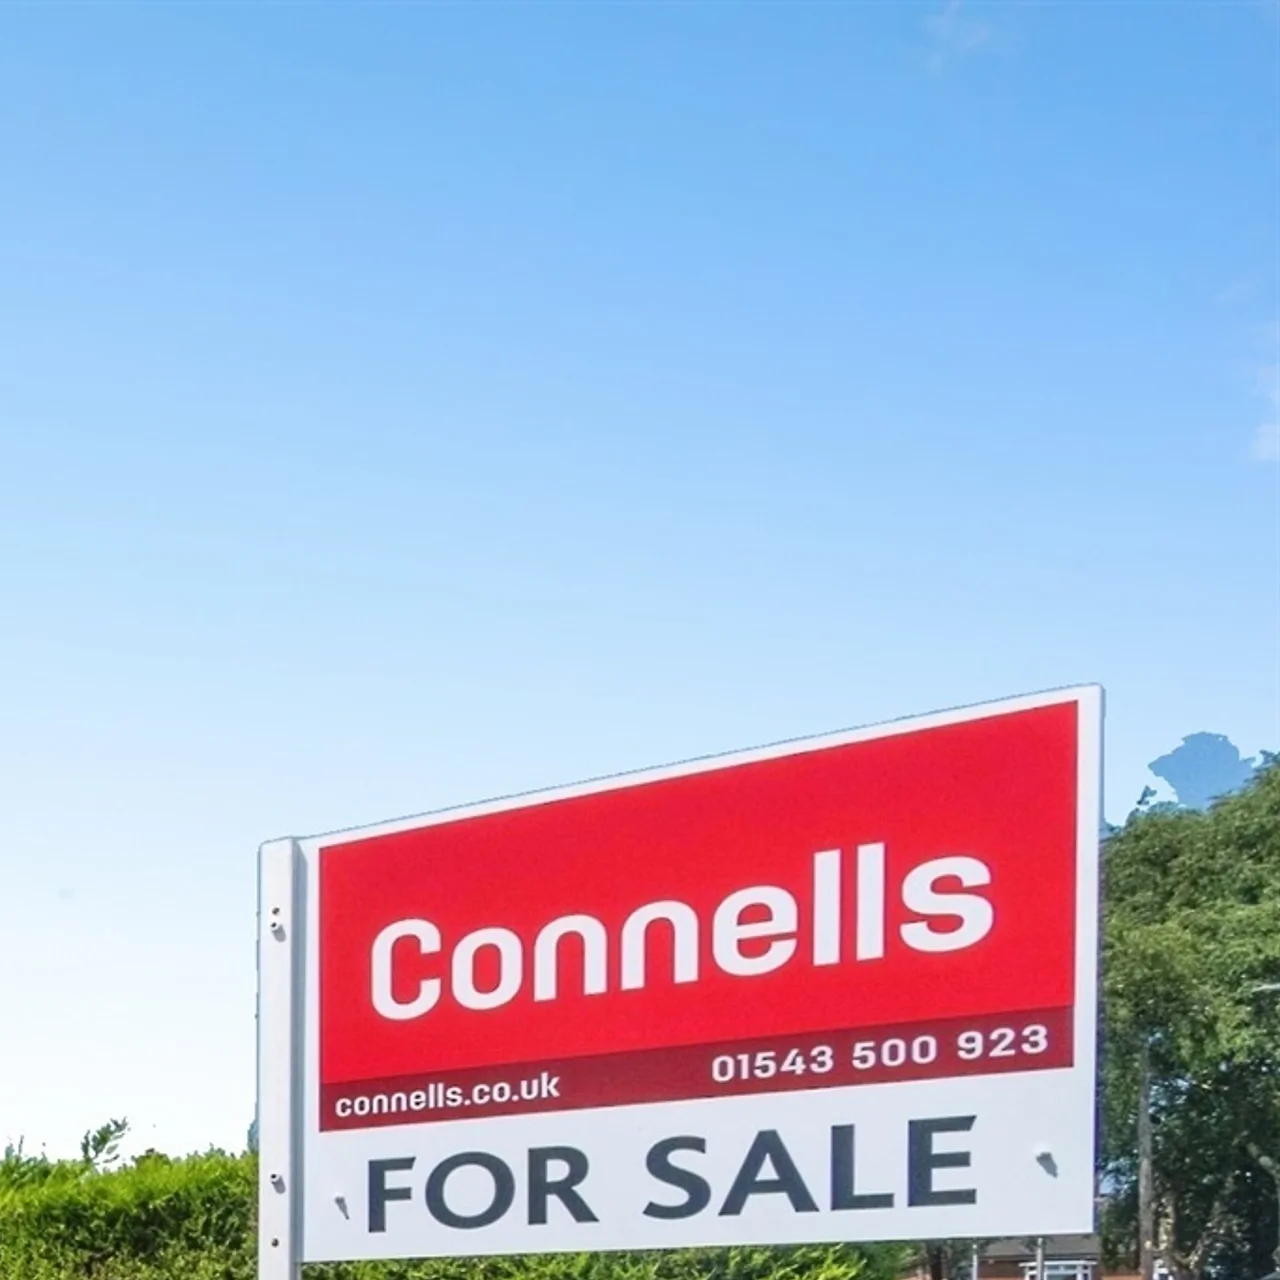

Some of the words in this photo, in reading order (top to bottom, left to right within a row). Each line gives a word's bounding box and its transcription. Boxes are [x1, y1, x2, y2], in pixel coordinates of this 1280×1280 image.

[371, 841, 994, 1021] Connells
[335, 1071, 561, 1117] connells.co.uk
[711, 1045, 835, 1083] 01543
[851, 1034, 938, 1069] 500
[957, 1024, 1049, 1059] 923
[367, 1146, 600, 1233] FOR
[642, 1115, 978, 1220] SALE
